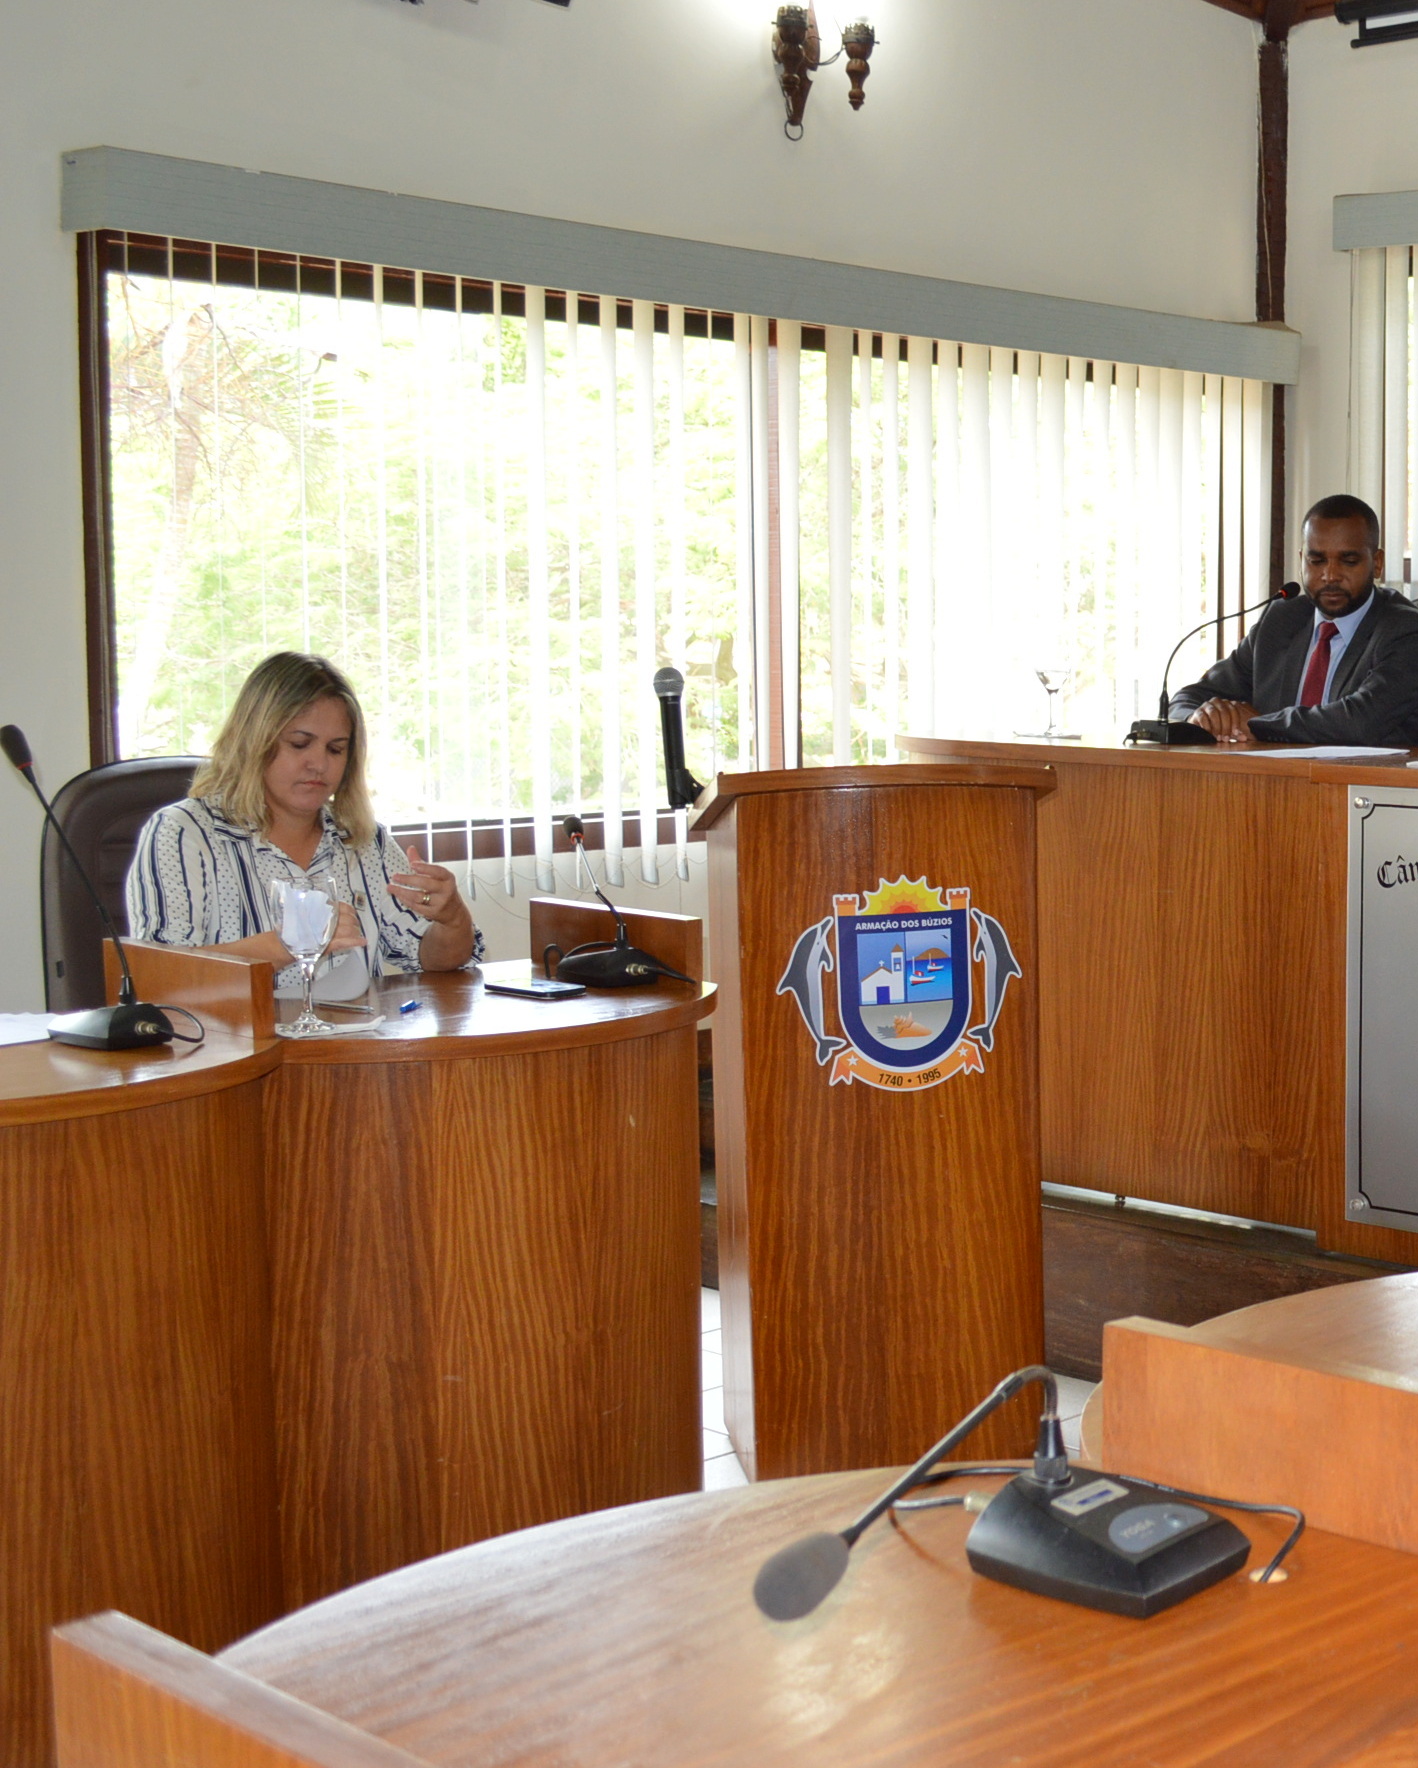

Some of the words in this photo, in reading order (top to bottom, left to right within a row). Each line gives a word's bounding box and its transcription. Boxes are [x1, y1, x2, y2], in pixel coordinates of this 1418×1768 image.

[855, 919, 899, 931] ARMAÇÃO
[901, 920, 919, 929] DOS
[921, 917, 953, 927] BÚZIOS
[879, 1073, 904, 1086] 1740
[917, 1068, 942, 1084] 1995
